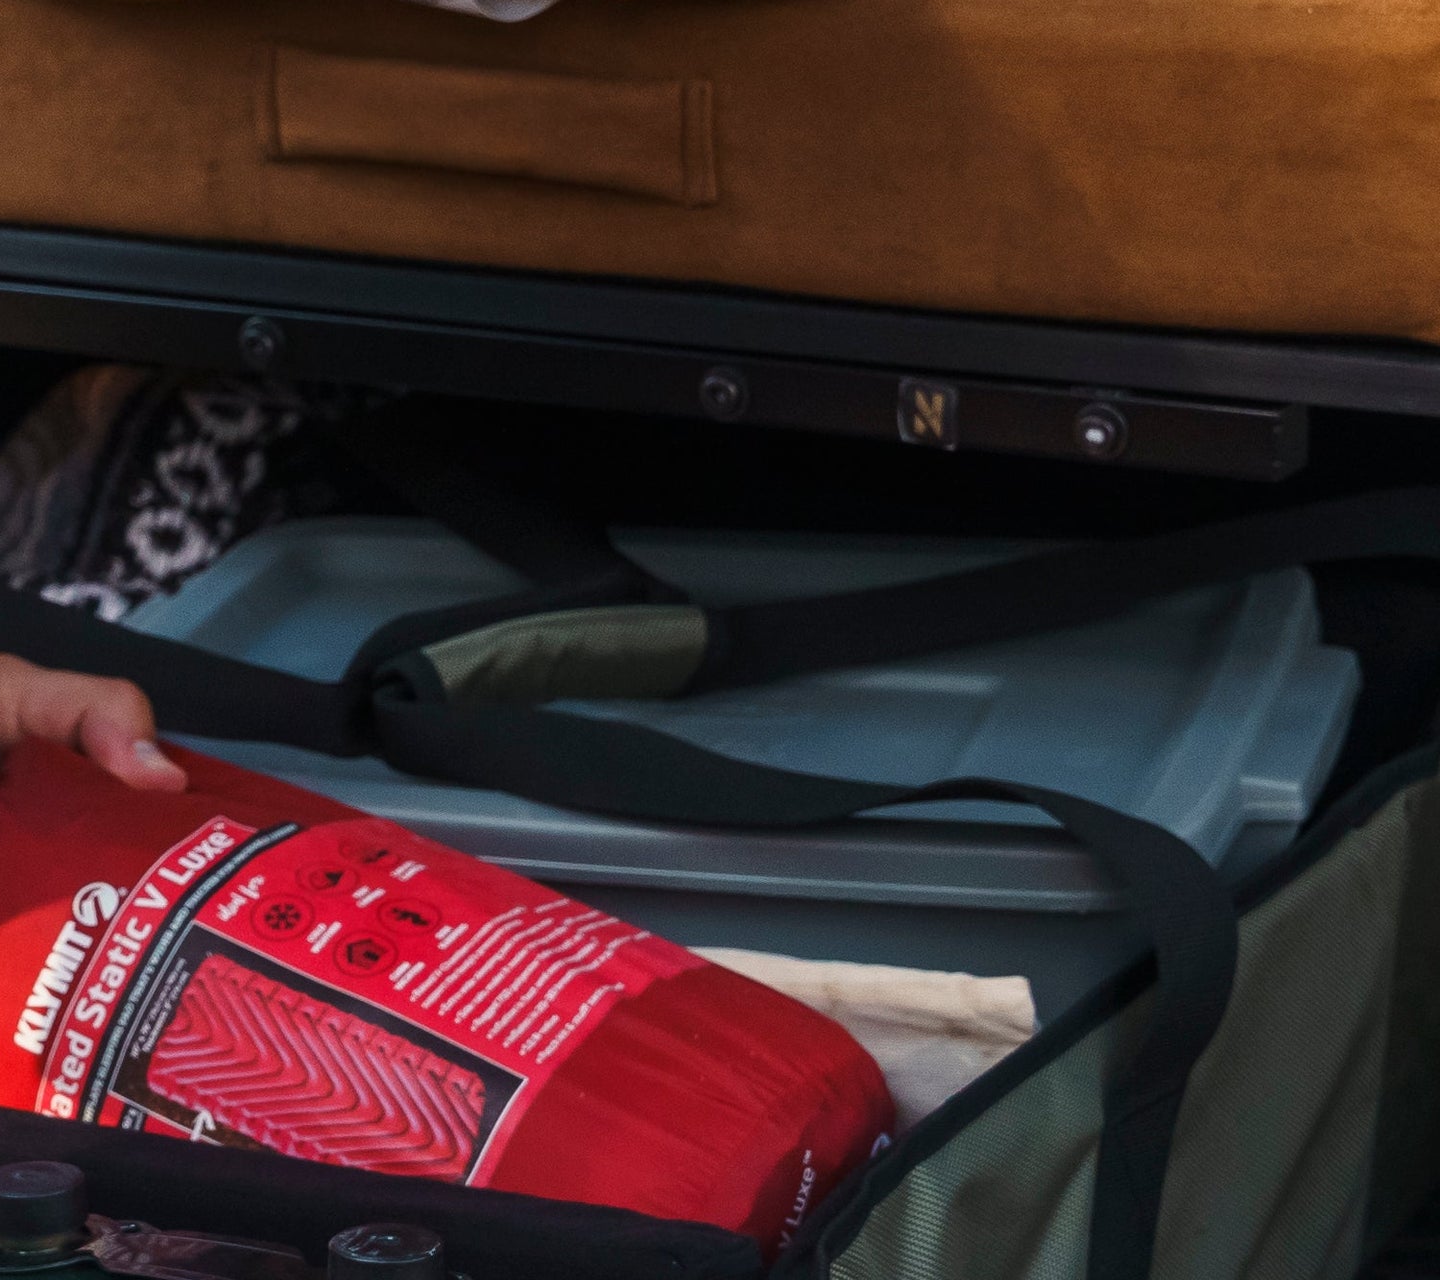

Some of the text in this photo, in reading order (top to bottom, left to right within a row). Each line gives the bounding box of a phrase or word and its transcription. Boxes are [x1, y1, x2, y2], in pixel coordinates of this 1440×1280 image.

[14, 921, 93, 1055] KLYMIT
[75, 917, 152, 1029] Static
[134, 883, 169, 910] V
